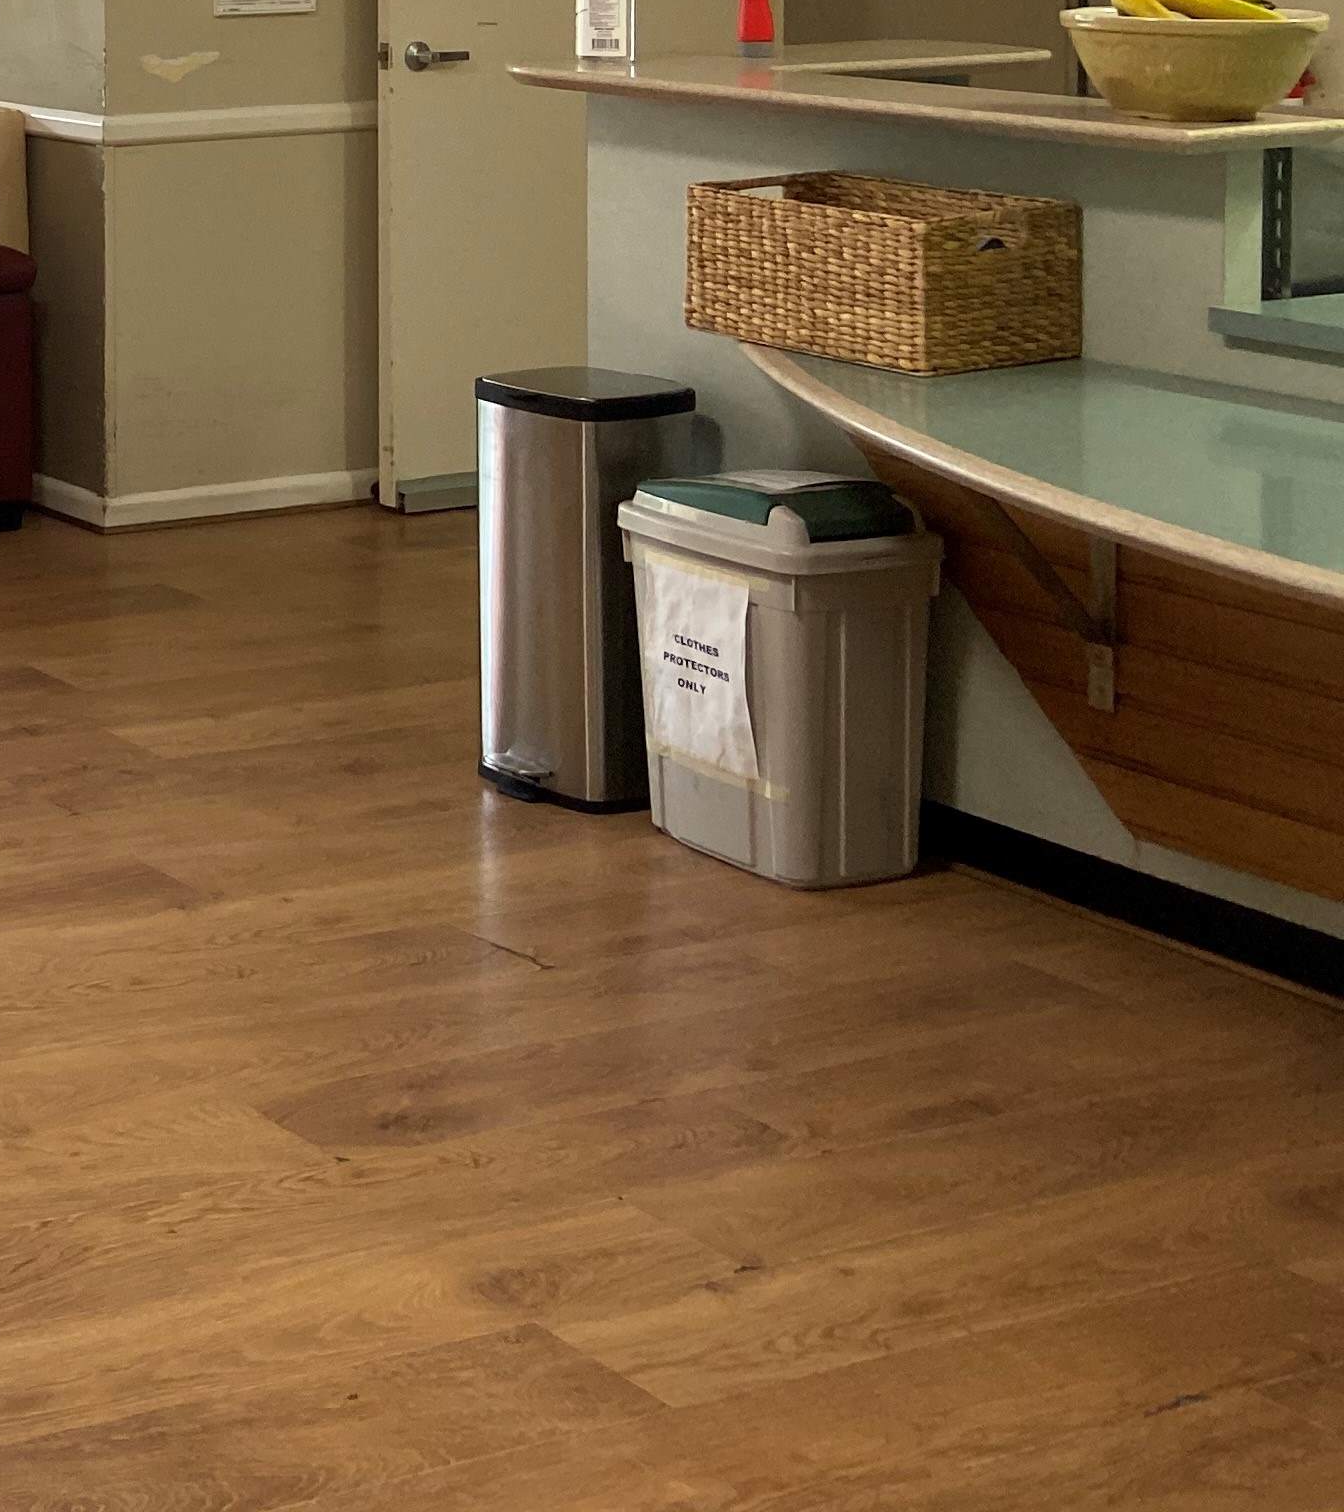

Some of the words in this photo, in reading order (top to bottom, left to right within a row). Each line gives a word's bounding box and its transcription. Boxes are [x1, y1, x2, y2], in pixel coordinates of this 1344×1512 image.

[673, 634, 719, 657] CLOTHES
[663, 651, 730, 683] PROTECTORS
[677, 678, 706, 694] ONLY
